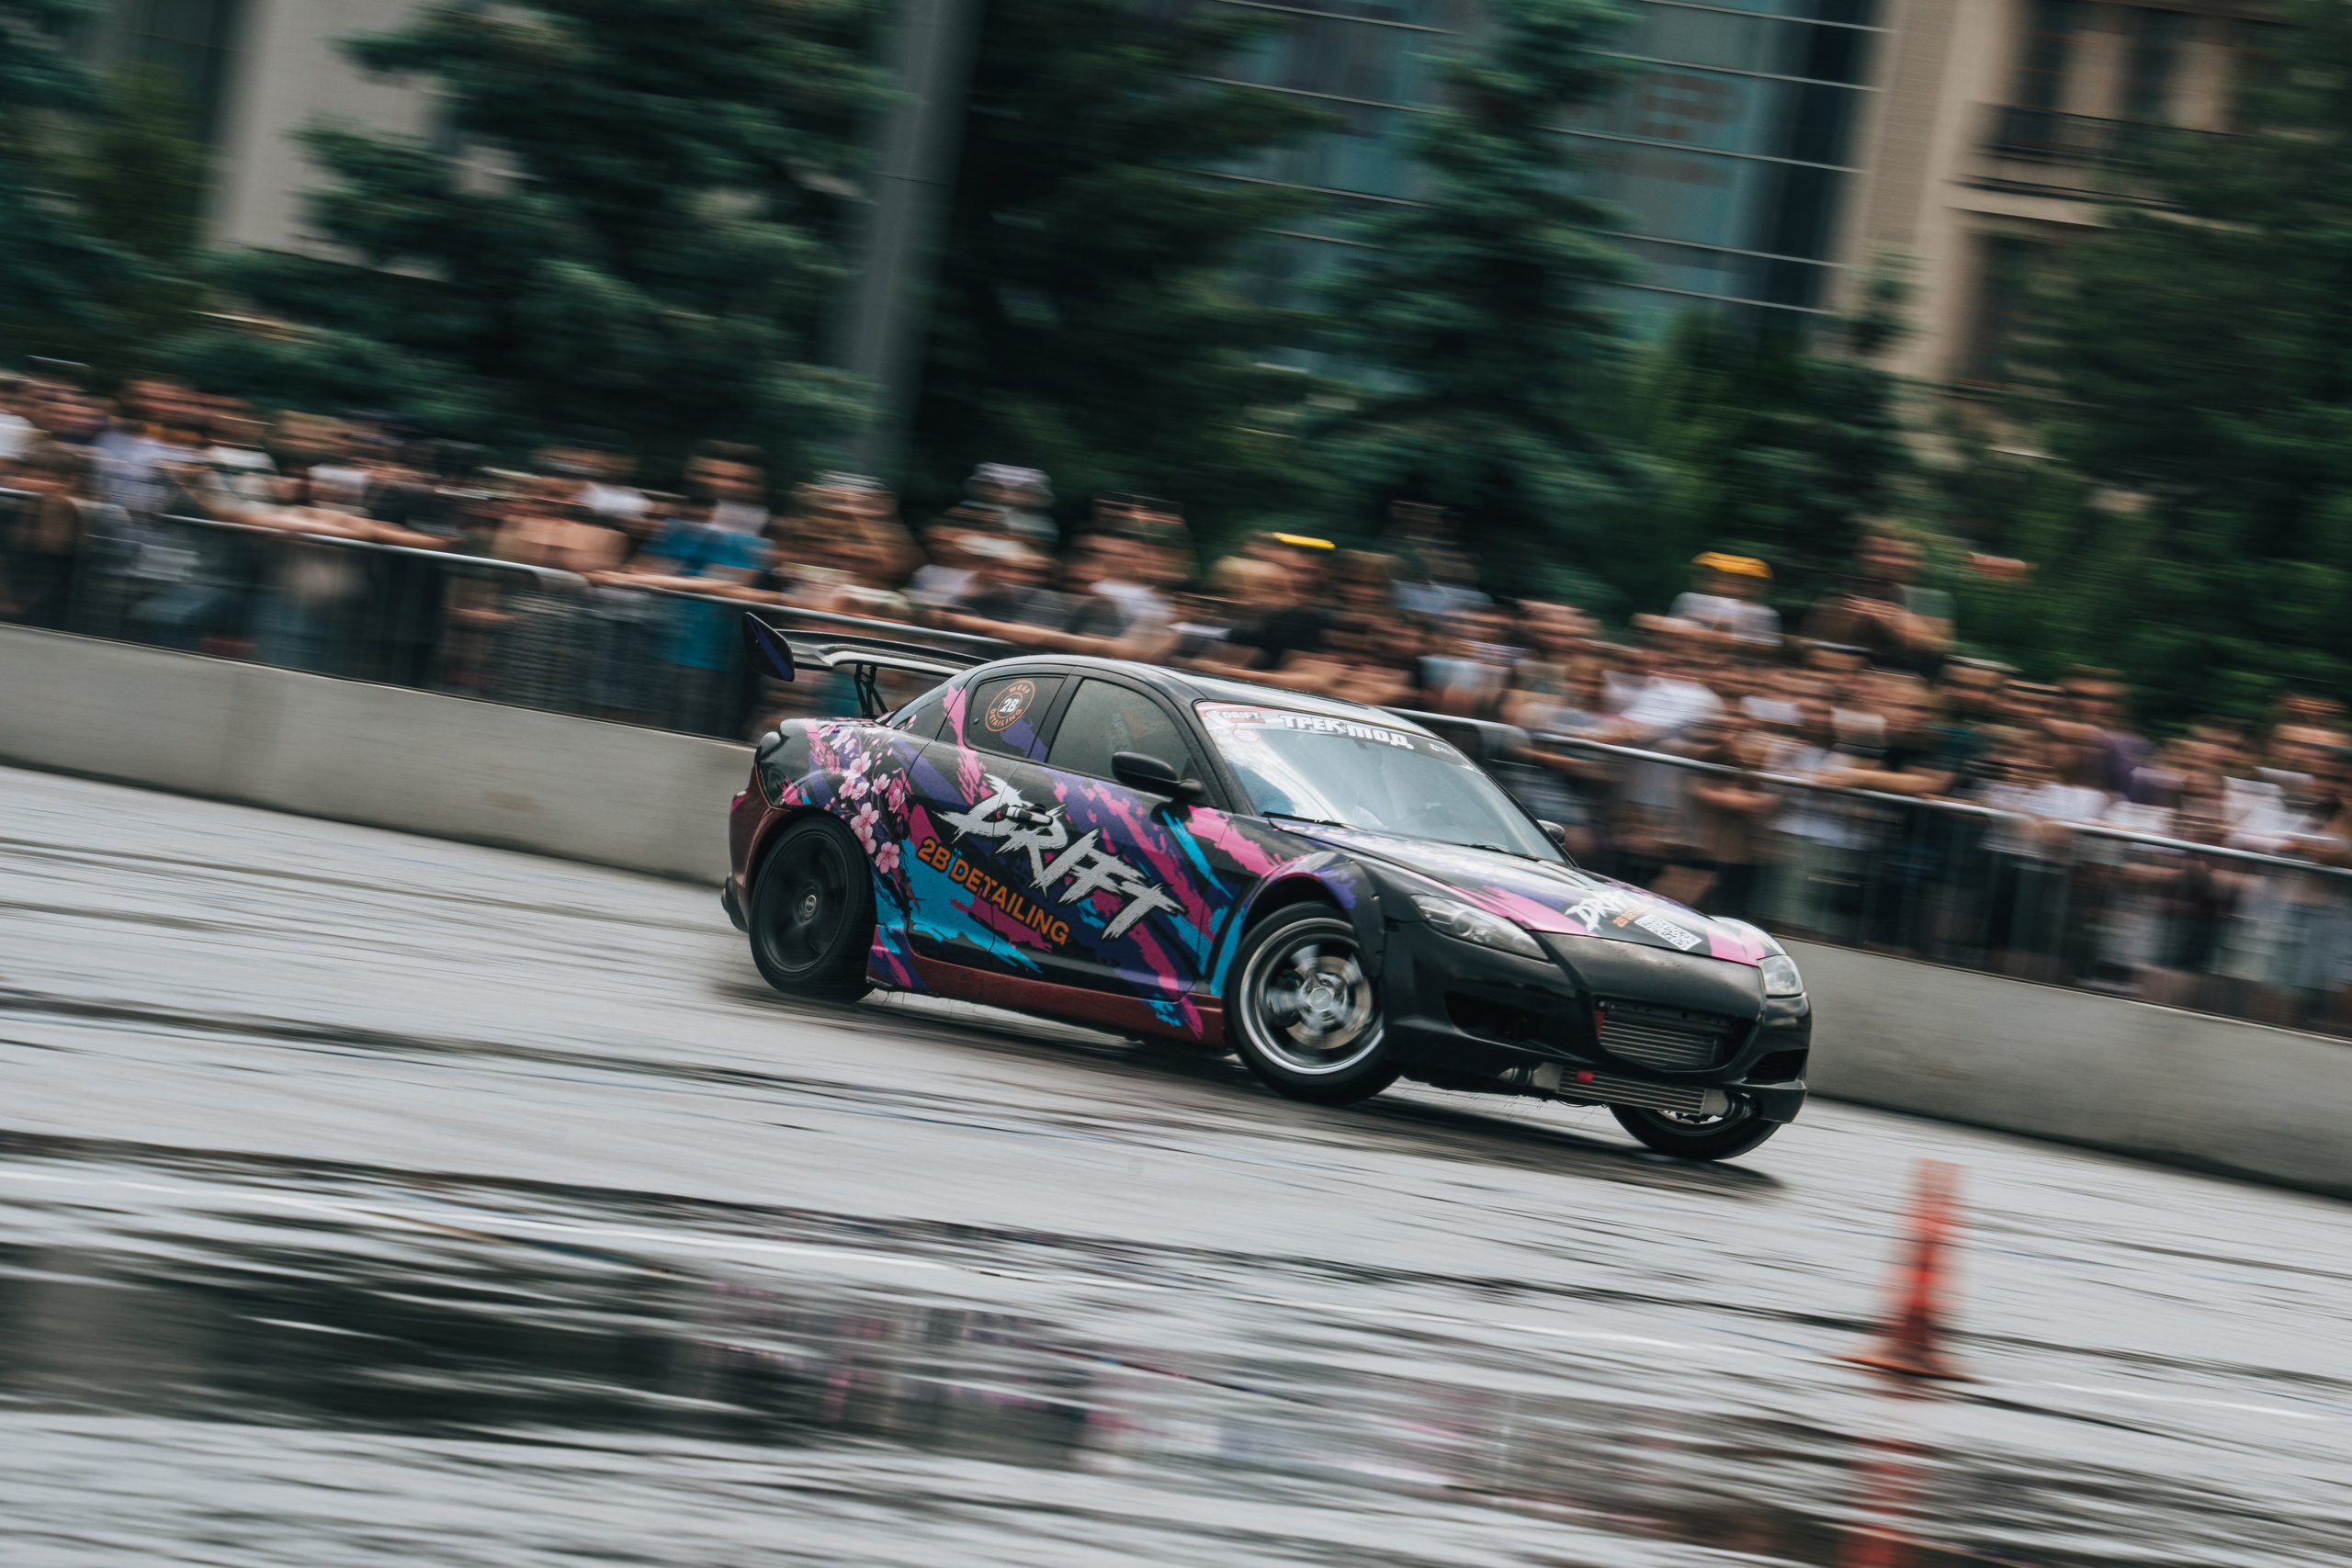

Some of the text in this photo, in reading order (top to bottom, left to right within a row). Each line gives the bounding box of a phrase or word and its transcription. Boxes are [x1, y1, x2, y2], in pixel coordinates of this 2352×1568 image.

[1009, 684, 1031, 694] WRAP
[999, 697, 1020, 713] 2B
[989, 707, 1023, 728] DETAILING
[1221, 711, 1260, 719] DRIFT
[932, 773, 1188, 941] DRIFT
[917, 838, 1070, 945] 2B DETAILING
